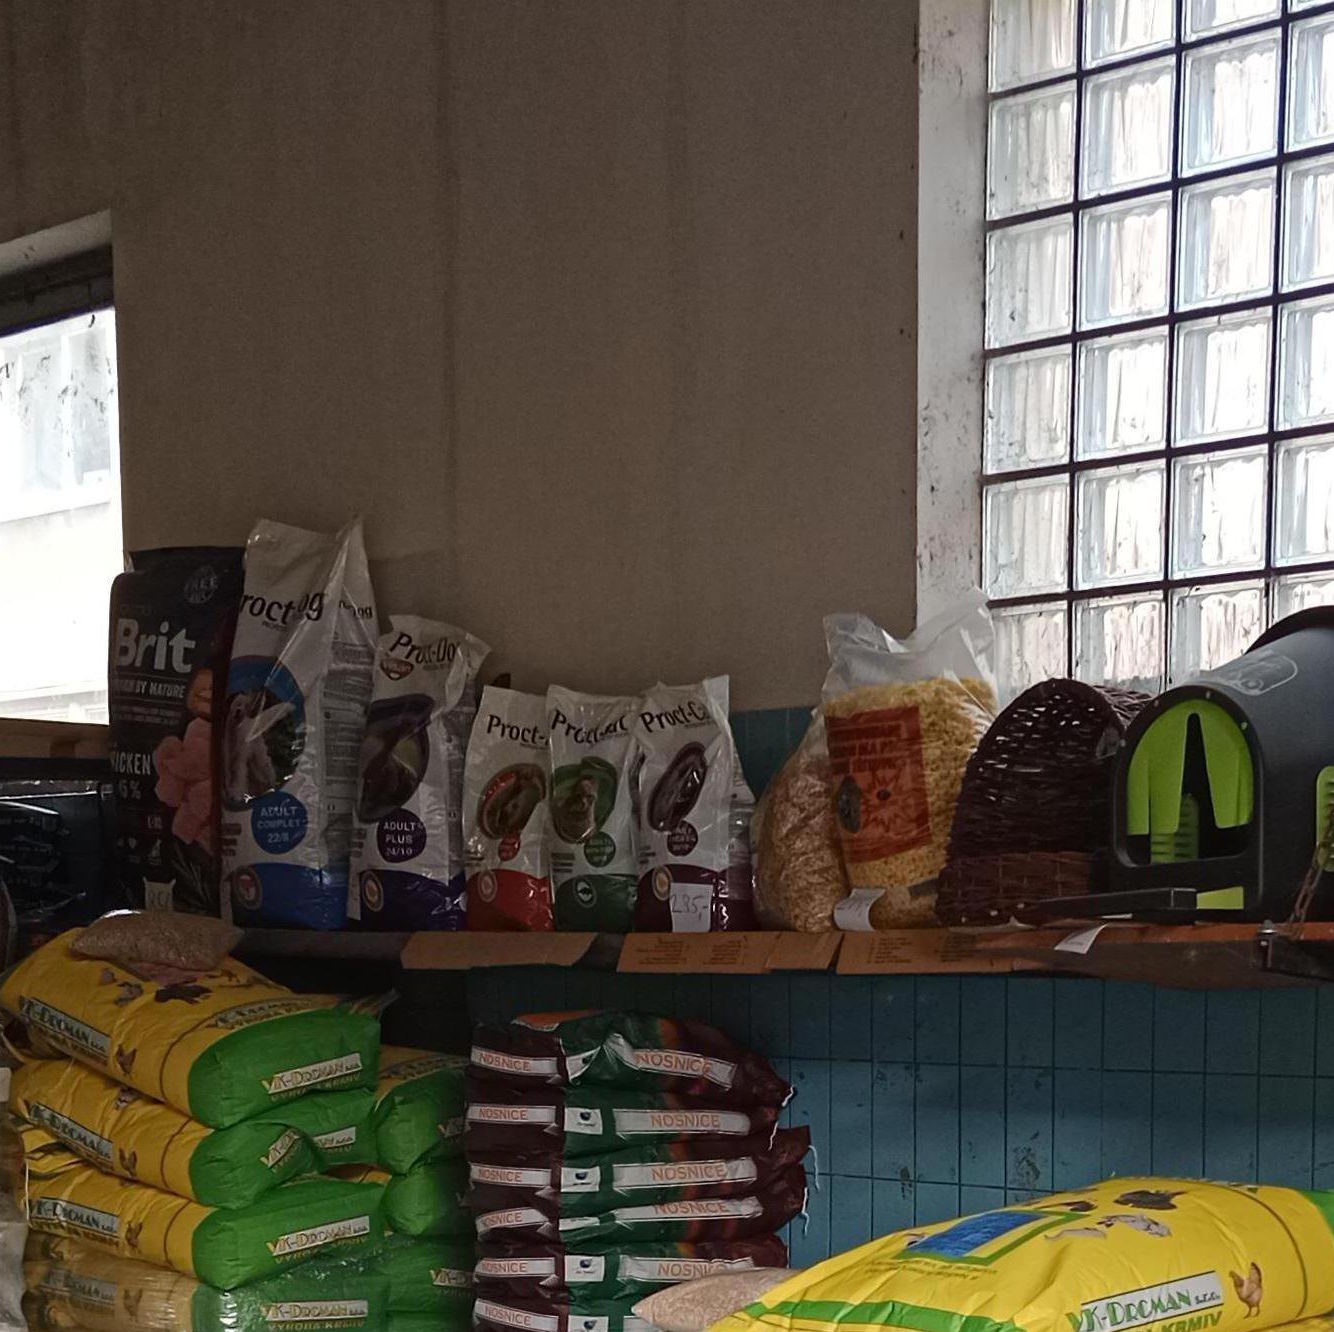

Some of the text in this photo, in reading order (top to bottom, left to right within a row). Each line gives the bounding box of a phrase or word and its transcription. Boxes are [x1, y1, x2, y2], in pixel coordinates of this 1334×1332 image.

[117, 617, 196, 673] Brit
[383, 821, 416, 832] ADULT
[633, 1053, 713, 1073] NOSNICE
[478, 1107, 527, 1121] NOSNICE
[650, 1113, 720, 1128] NOSNICE
[478, 1170, 523, 1184] NOSNICE
[651, 1164, 726, 1182] NOSNICE
[481, 1261, 527, 1273] NOSNICE
[484, 1305, 532, 1327] NOSNICE
